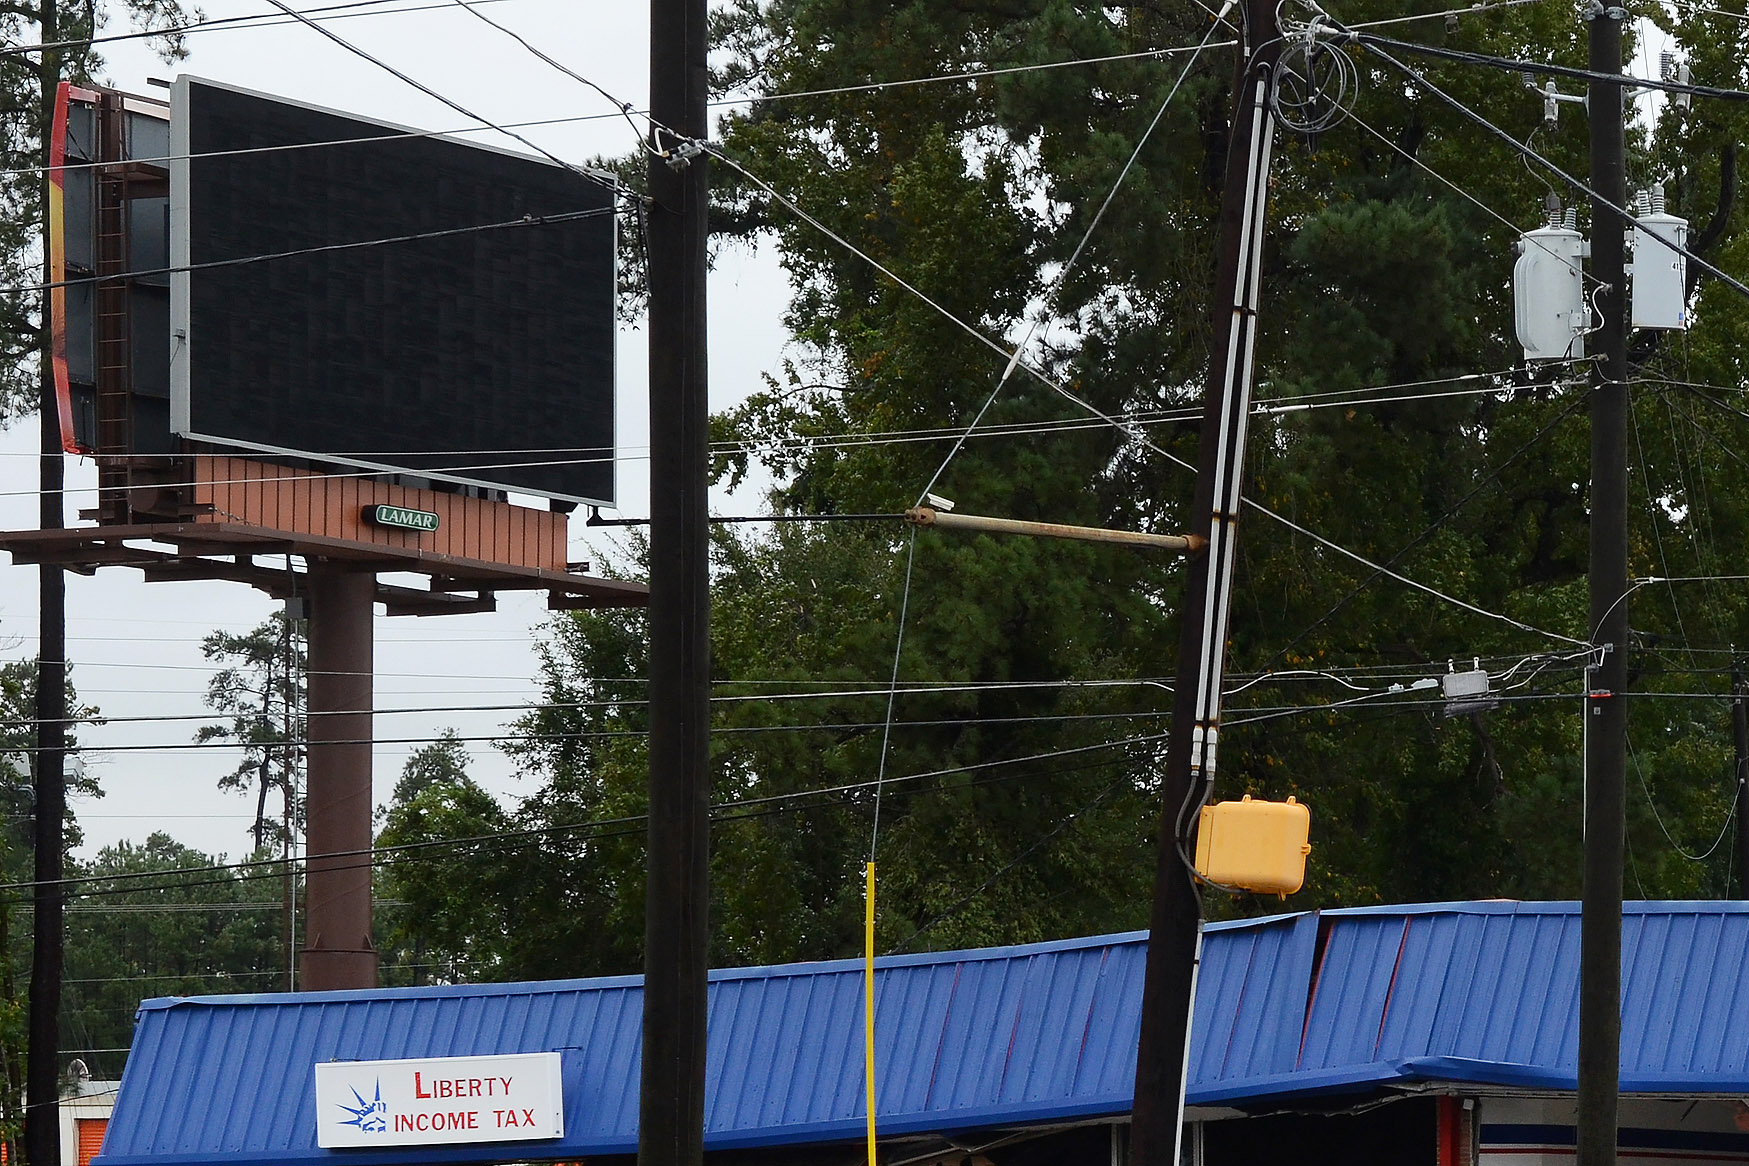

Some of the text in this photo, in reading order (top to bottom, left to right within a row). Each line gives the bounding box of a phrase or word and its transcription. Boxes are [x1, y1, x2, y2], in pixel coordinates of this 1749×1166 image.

[380, 508, 433, 528] LAMAR
[414, 1071, 513, 1100] LIBERTY
[394, 1108, 536, 1132] INCOME TAX
